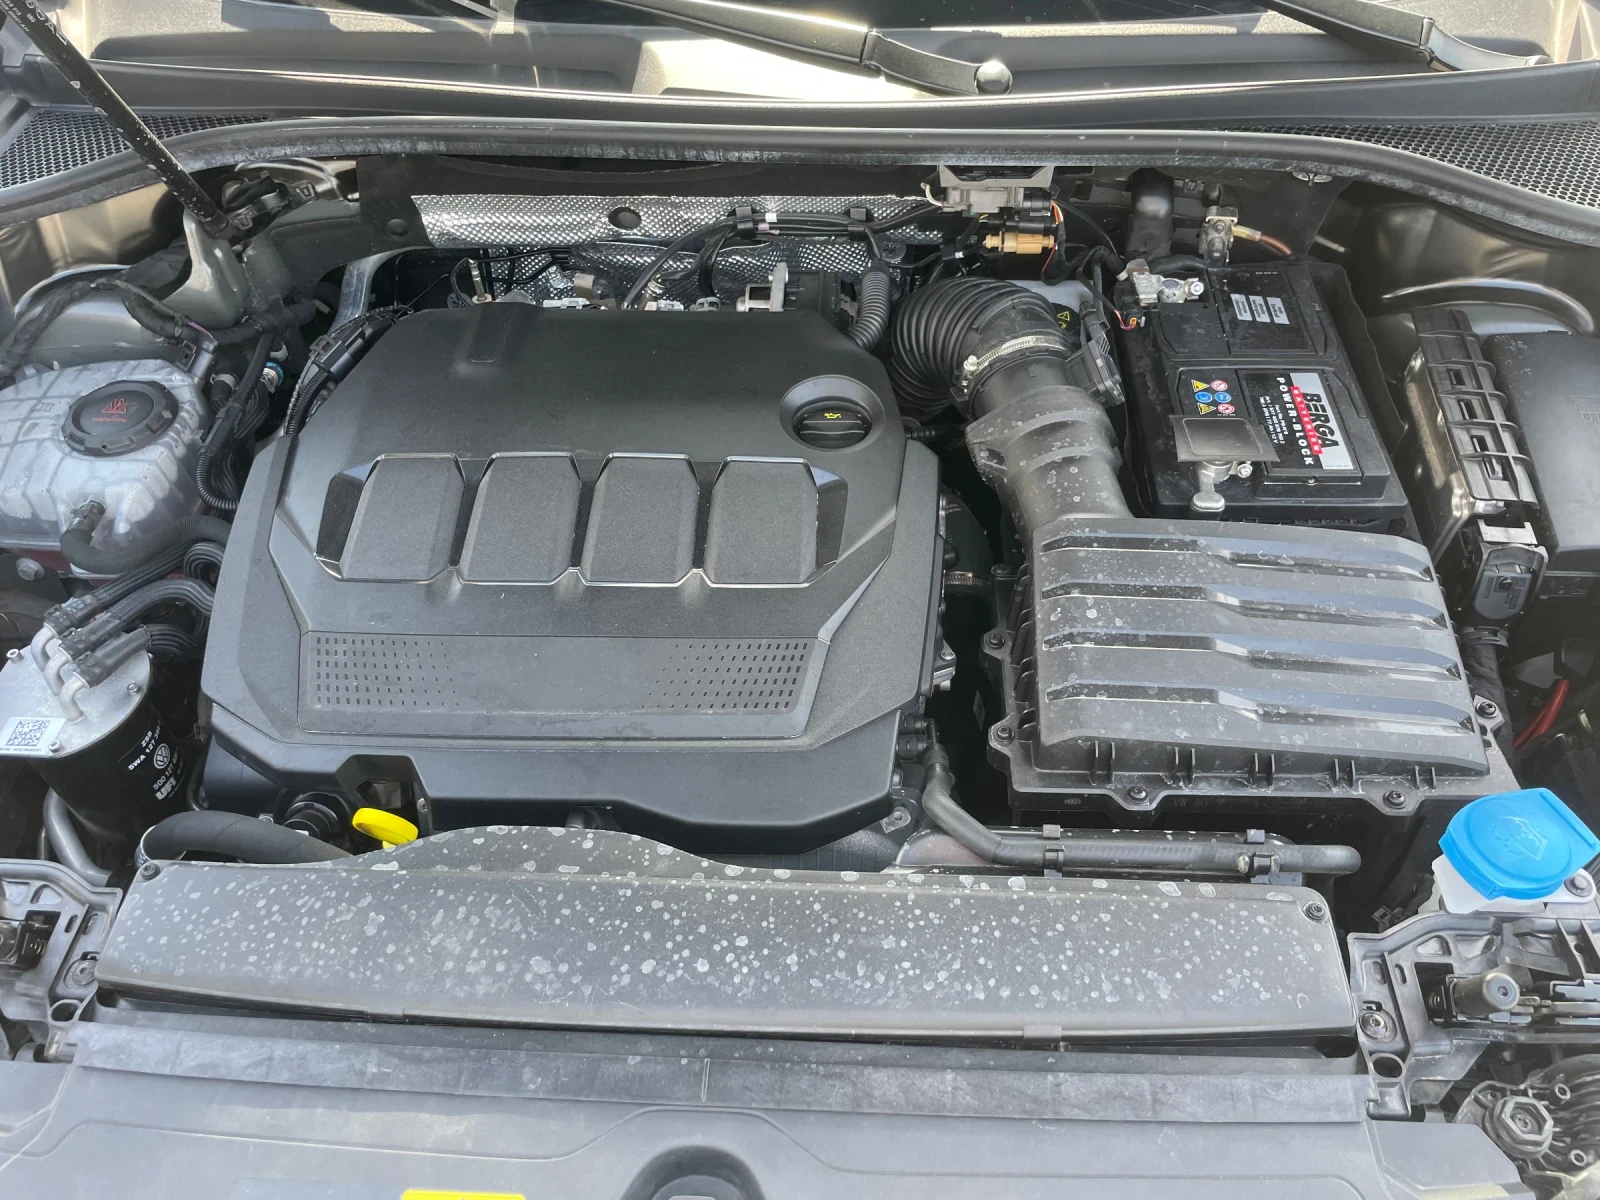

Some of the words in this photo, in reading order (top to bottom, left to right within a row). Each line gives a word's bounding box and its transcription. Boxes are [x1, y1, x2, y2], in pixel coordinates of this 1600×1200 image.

[1276, 377, 1314, 465] POWER-BLOCK
[1293, 389, 1320, 451] BATTERIEN
[1301, 392, 1340, 449] BERGA
[128, 755, 146, 771] 5WA
[145, 739, 156, 753] 127
[155, 776, 177, 799] UFI
